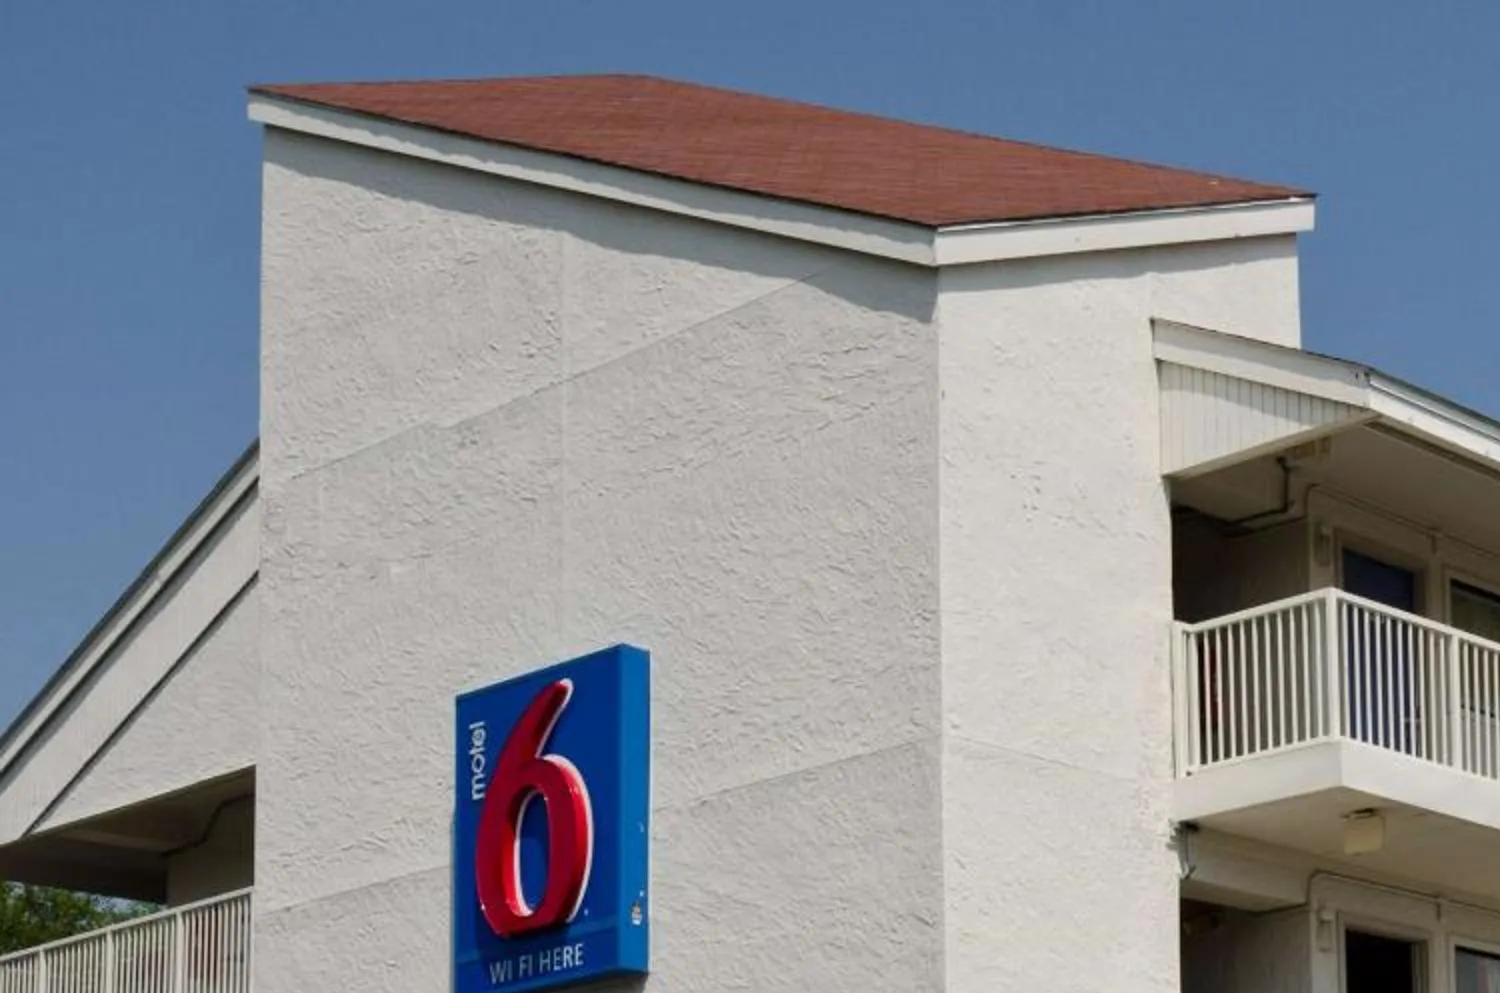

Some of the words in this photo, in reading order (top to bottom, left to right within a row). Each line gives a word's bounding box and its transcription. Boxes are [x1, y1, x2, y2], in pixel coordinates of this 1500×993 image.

[468, 721, 487, 800] motel
[475, 677, 595, 938] 6
[539, 943, 585, 974] HERE
